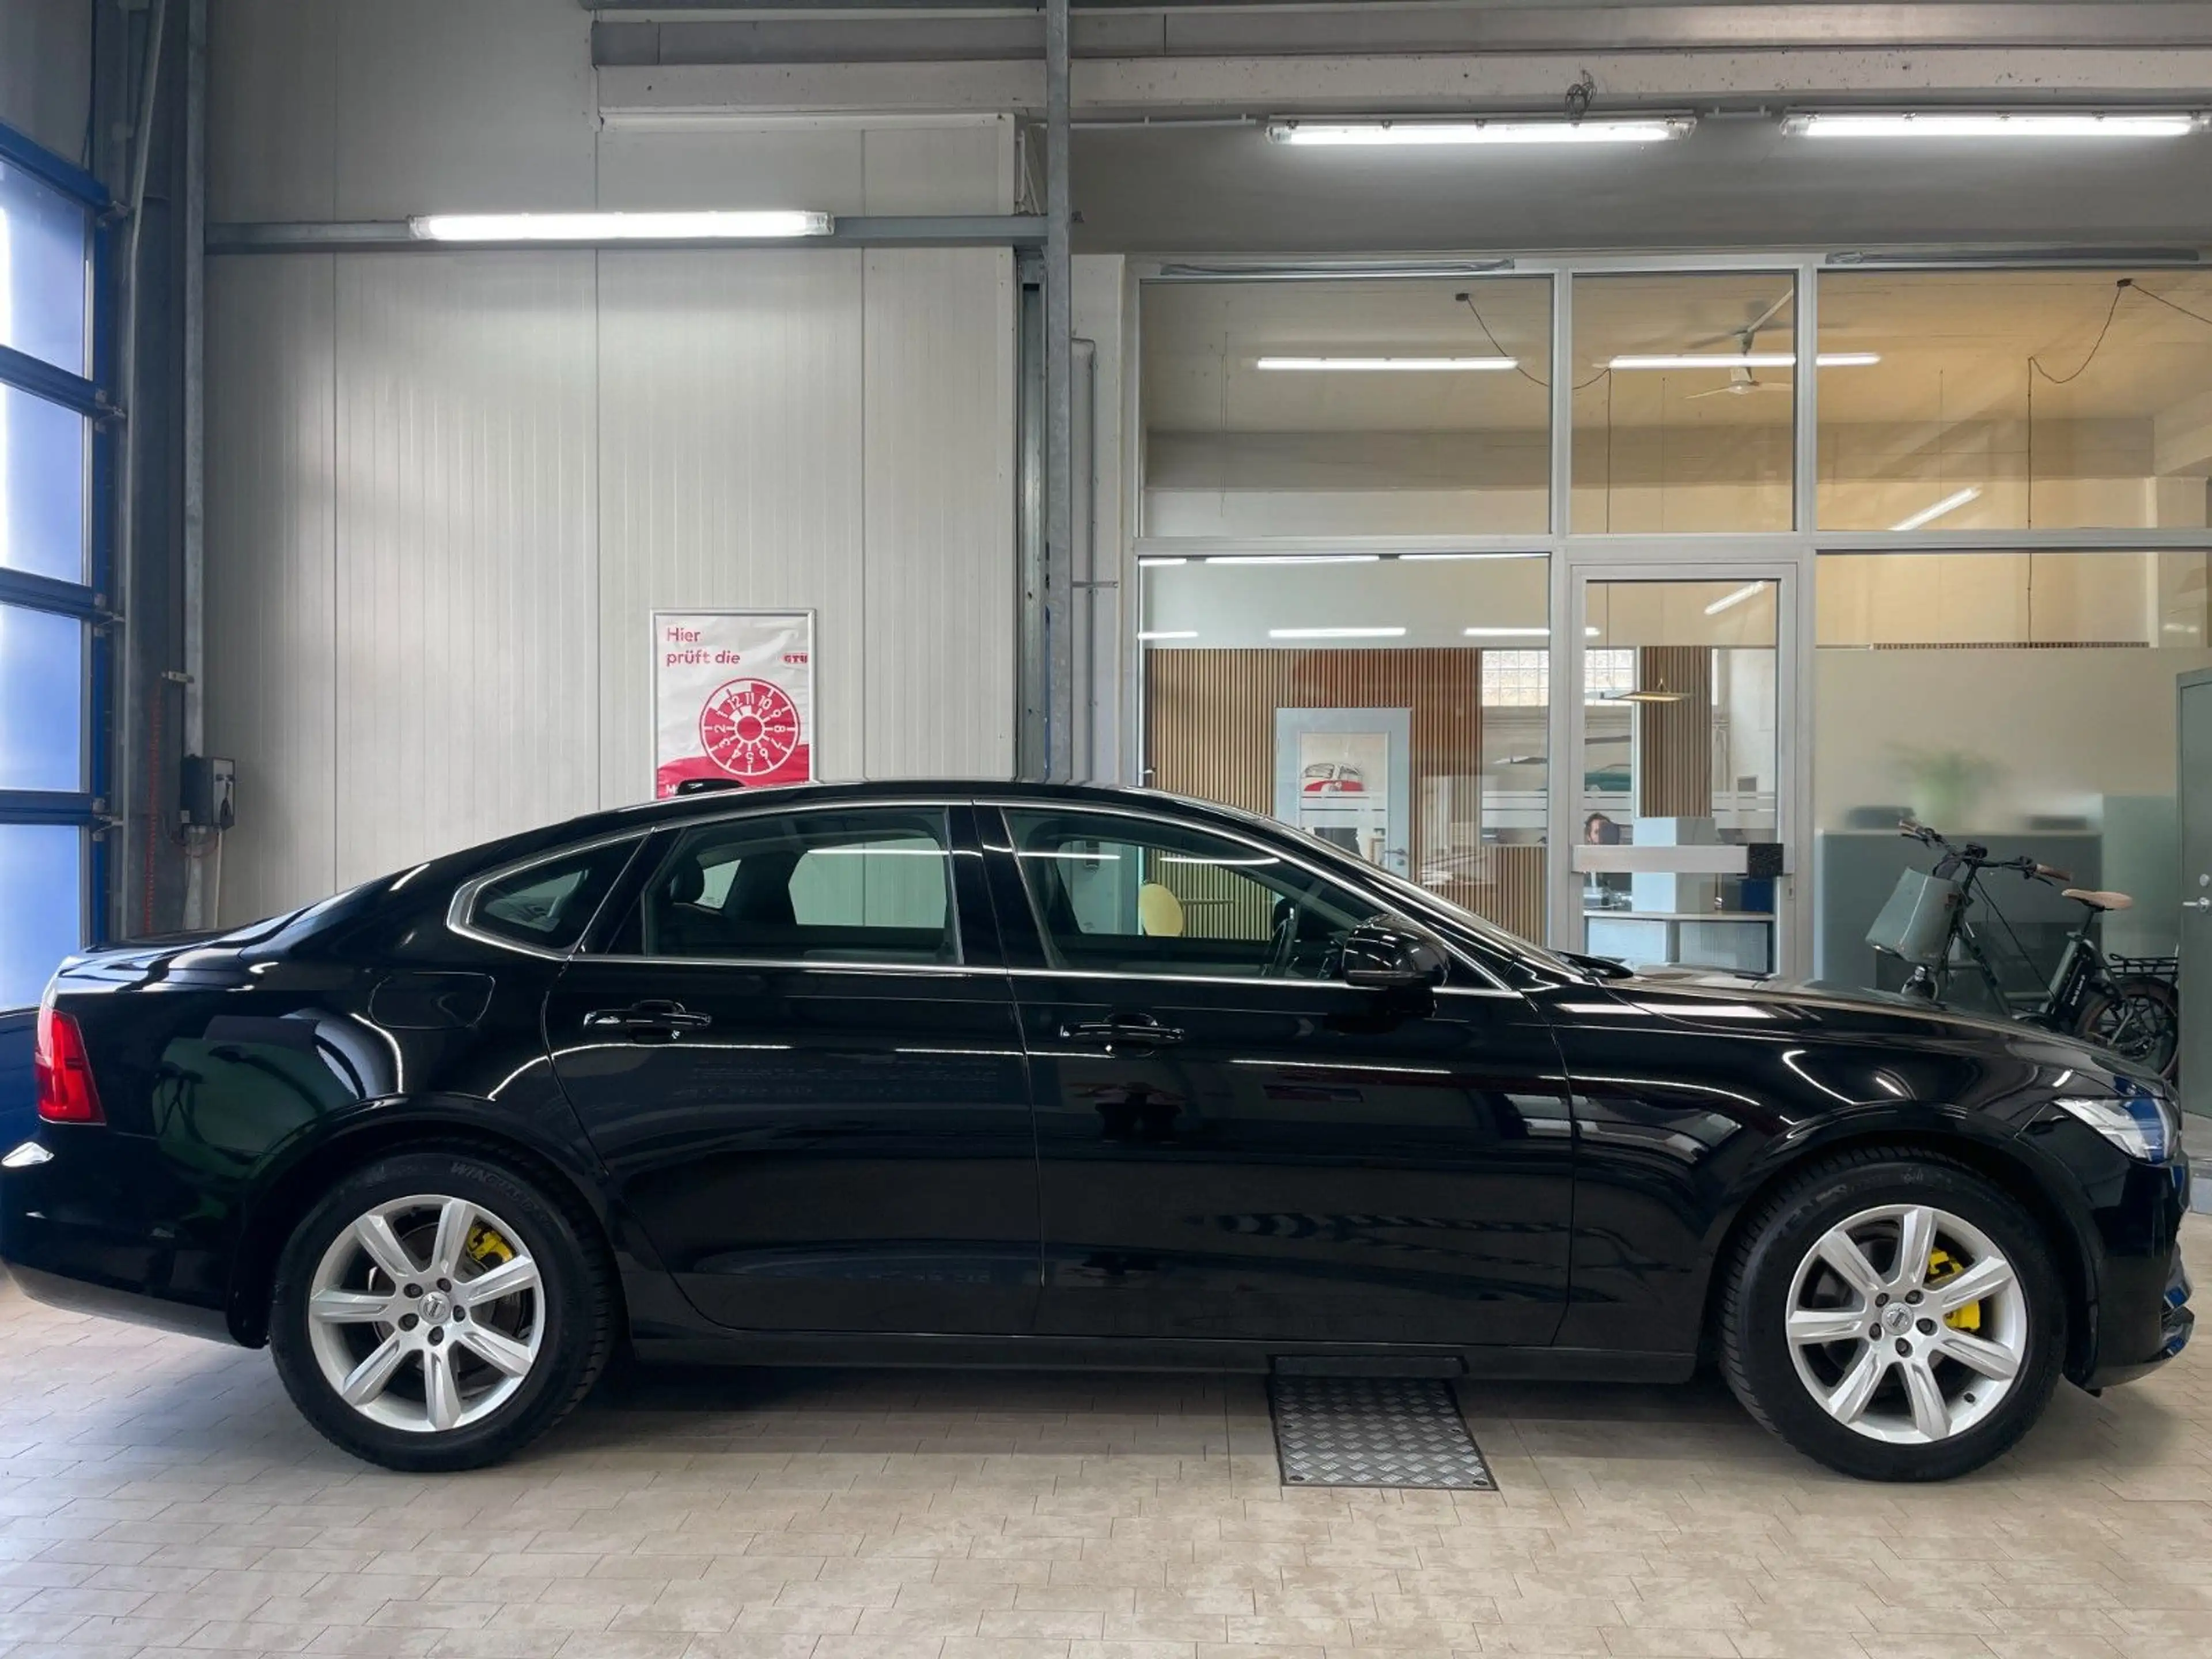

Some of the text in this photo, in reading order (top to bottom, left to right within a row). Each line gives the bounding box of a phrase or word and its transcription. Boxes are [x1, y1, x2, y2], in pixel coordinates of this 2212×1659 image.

[666, 627, 700, 642] Hier
[666, 650, 741, 666] prüft die
[727, 695, 743, 710] 12
[745, 692, 755, 704] 11
[758, 695, 772, 710] 10
[716, 710, 729, 718] 1
[770, 709, 782, 718] 9
[714, 724, 726, 733] 2
[774, 725, 786, 733] 8
[719, 738, 730, 748] 3
[771, 738, 782, 748] 7
[732, 749, 742, 759] 4
[745, 752, 754, 764] 5
[759, 748, 768, 759] 6
